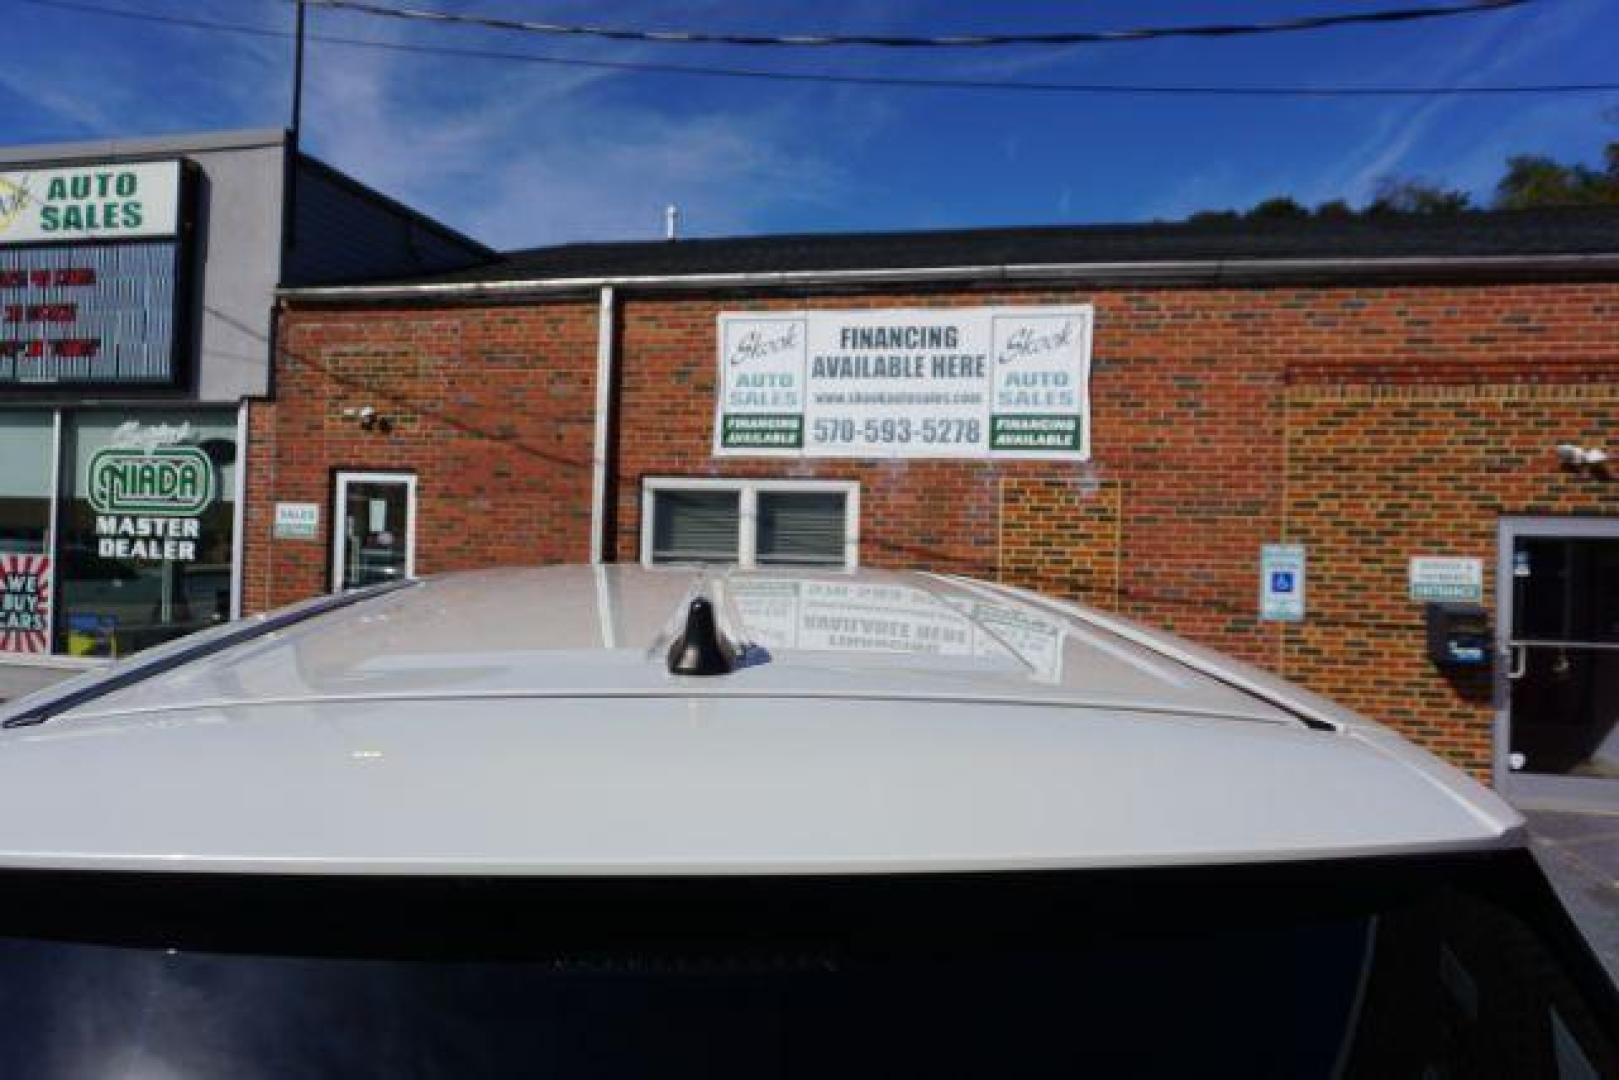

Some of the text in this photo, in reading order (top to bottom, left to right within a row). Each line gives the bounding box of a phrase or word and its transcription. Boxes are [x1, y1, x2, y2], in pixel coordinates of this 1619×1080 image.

[47, 171, 139, 201] AUTO
[40, 202, 143, 231] SALES
[840, 326, 959, 349] FINANCING
[812, 353, 985, 378] AVAILABLE HERE
[735, 373, 794, 387] AUTO
[1004, 371, 1069, 387] AUTO
[730, 391, 798, 406] SALES
[998, 391, 1074, 406] SALES
[814, 417, 981, 445] 570-593-5278
[98, 463, 198, 497] NIADA
[95, 516, 200, 537] MASTER
[98, 538, 196, 560] DEALER
[6, 575, 38, 593] WE
[3, 593, 39, 612] BUY
